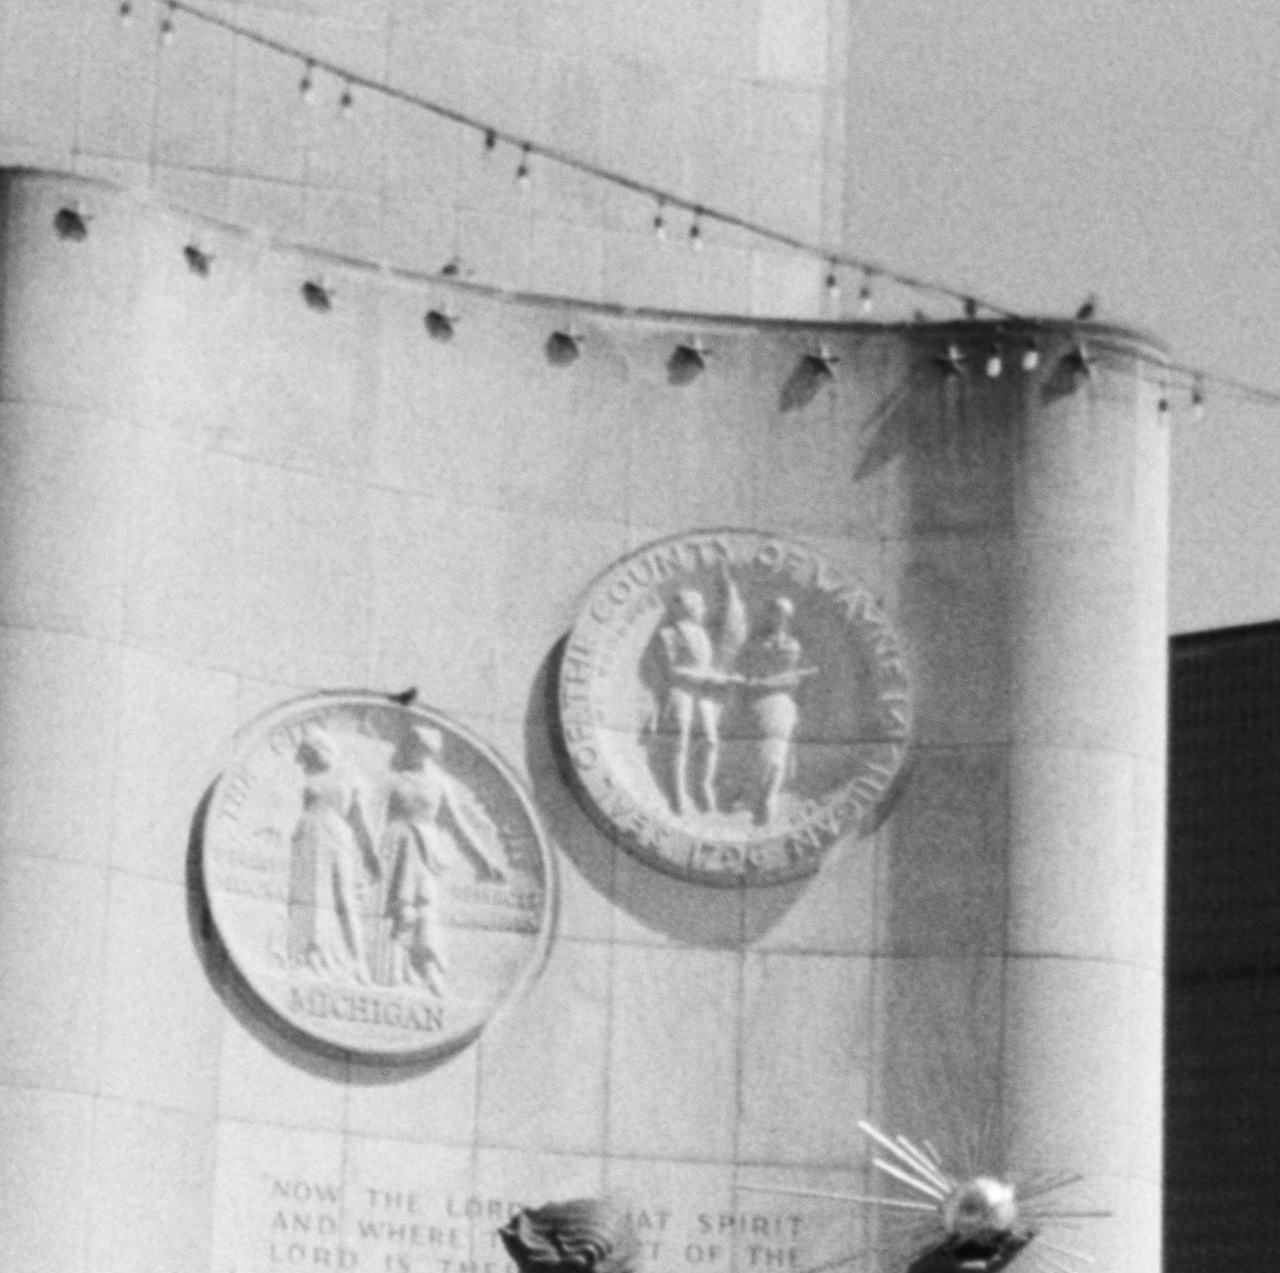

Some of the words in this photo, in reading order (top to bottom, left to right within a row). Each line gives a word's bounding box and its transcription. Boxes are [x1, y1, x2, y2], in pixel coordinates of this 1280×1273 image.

[589, 539, 731, 625] COUNTY
[289, 987, 446, 1033] MICHIGAN
[273, 1179, 337, 1204] NOW
[368, 1187, 421, 1214] THE
[697, 1211, 804, 1237] SPIRIT
[269, 1243, 360, 1271] LORD
[272, 1210, 337, 1237] AND
[357, 1219, 461, 1250] WHERE
[685, 1243, 721, 1266] OF
[747, 1244, 800, 1270] THE
